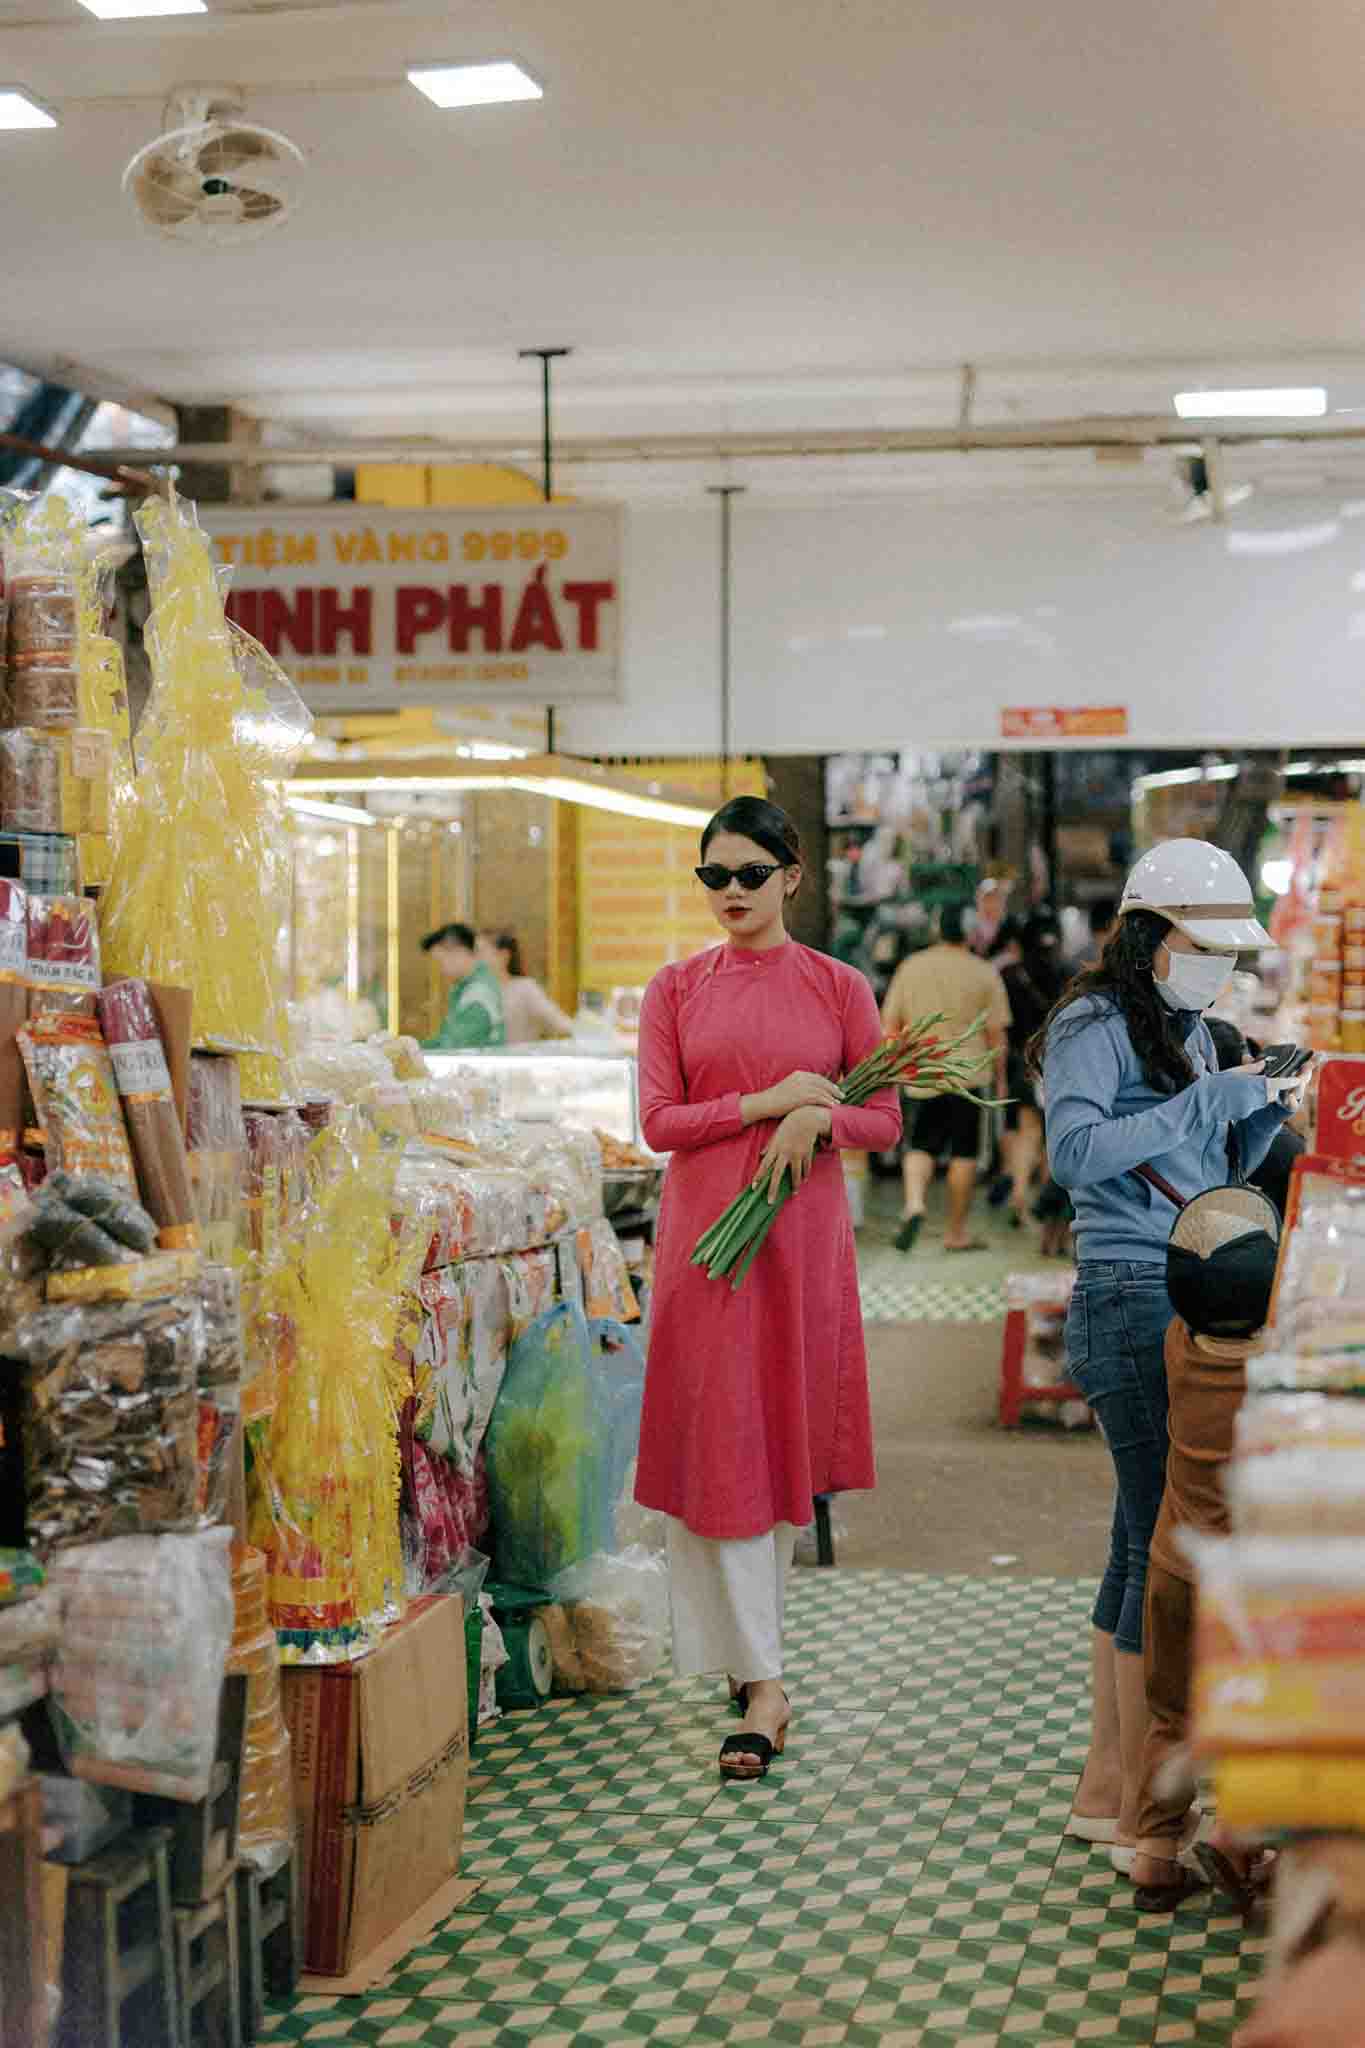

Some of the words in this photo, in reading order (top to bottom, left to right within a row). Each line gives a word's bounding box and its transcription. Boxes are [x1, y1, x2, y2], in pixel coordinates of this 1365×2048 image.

[214, 529, 317, 569] TIỆM
[333, 527, 449, 562] VÀNG
[464, 531, 568, 560] 9999
[224, 586, 371, 656] INH
[395, 561, 615, 654] PHÁT
